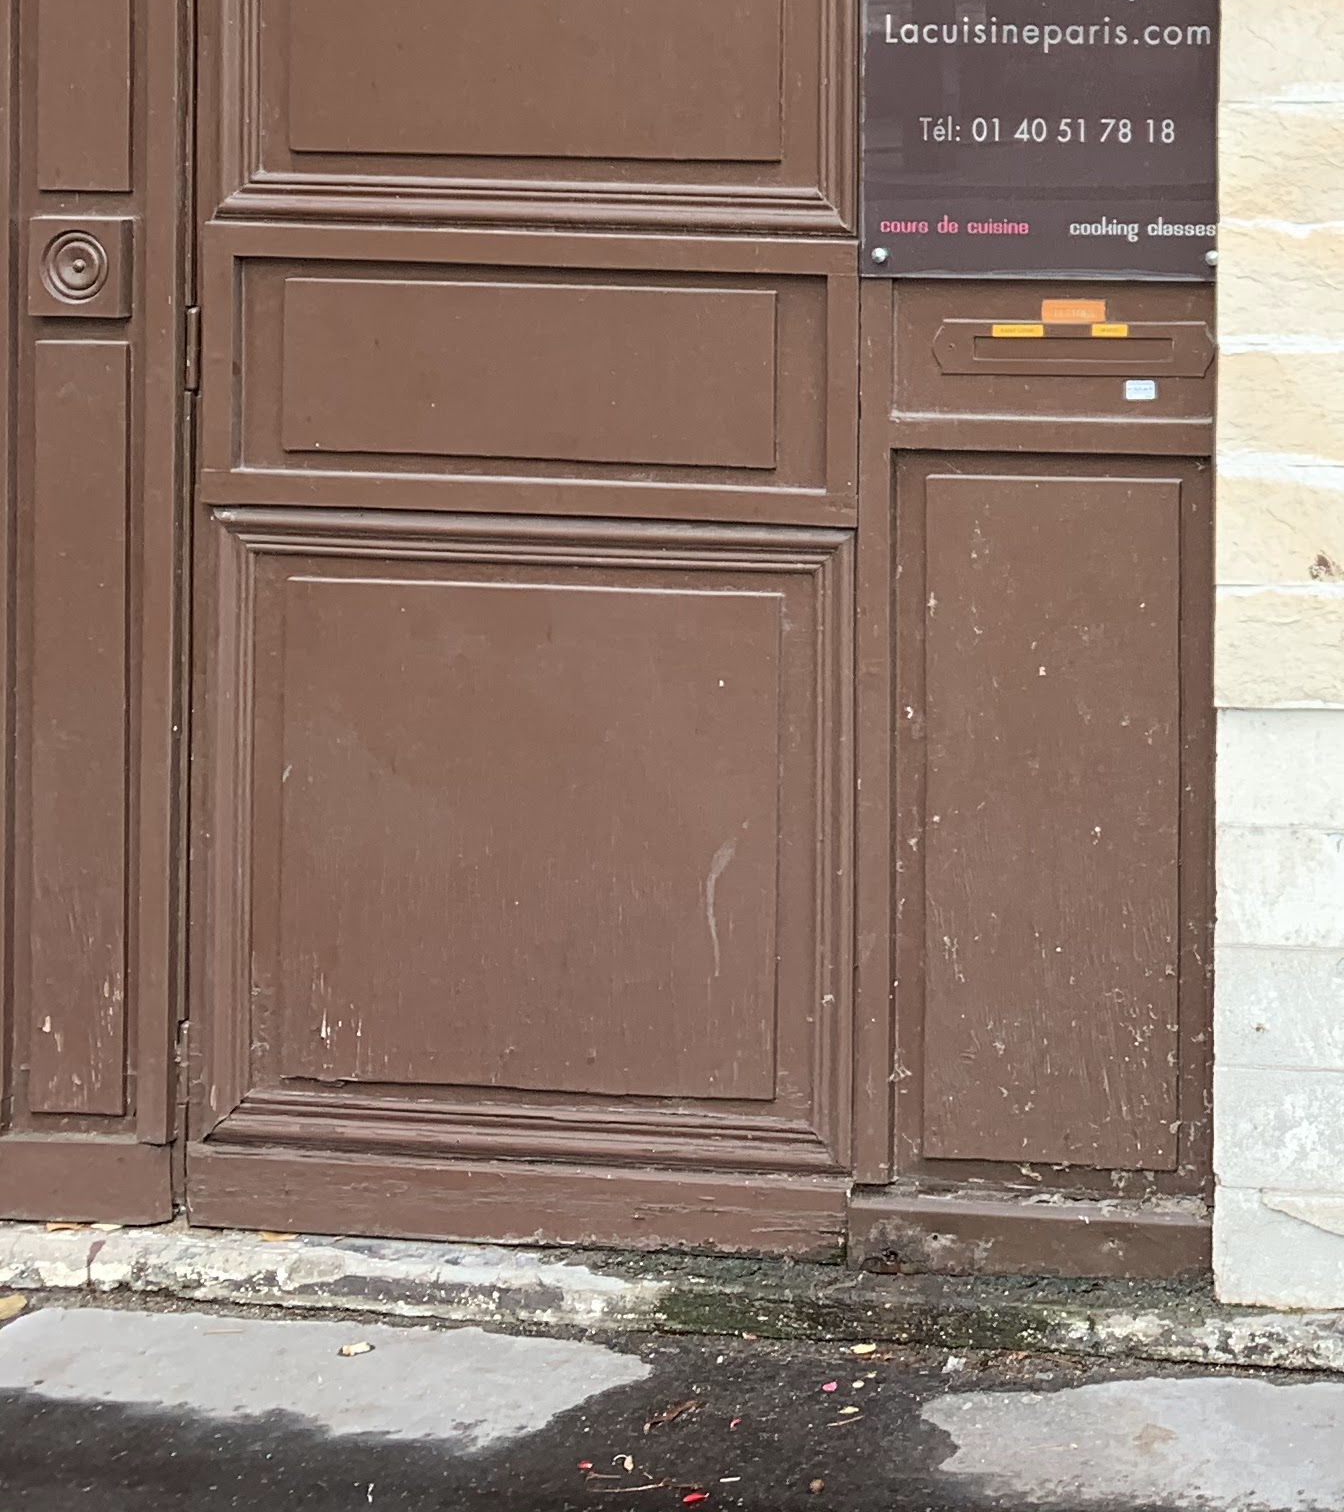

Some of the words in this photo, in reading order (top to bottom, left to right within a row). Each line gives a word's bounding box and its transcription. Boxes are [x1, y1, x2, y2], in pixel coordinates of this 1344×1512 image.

[885, 14, 1211, 54] Lacuisineparis.com
[919, 115, 961, 142] Tél:
[972, 117, 999, 142] 01
[1013, 117, 1047, 143] 40
[1057, 118, 1085, 143] 51
[1100, 118, 1132, 143] 78
[1146, 119, 1175, 144] 18
[880, 220, 929, 234] cours
[938, 216, 958, 234] de
[967, 218, 1029, 235] cuisine
[1069, 217, 1139, 243] cooking
[1147, 217, 1216, 238] classes
